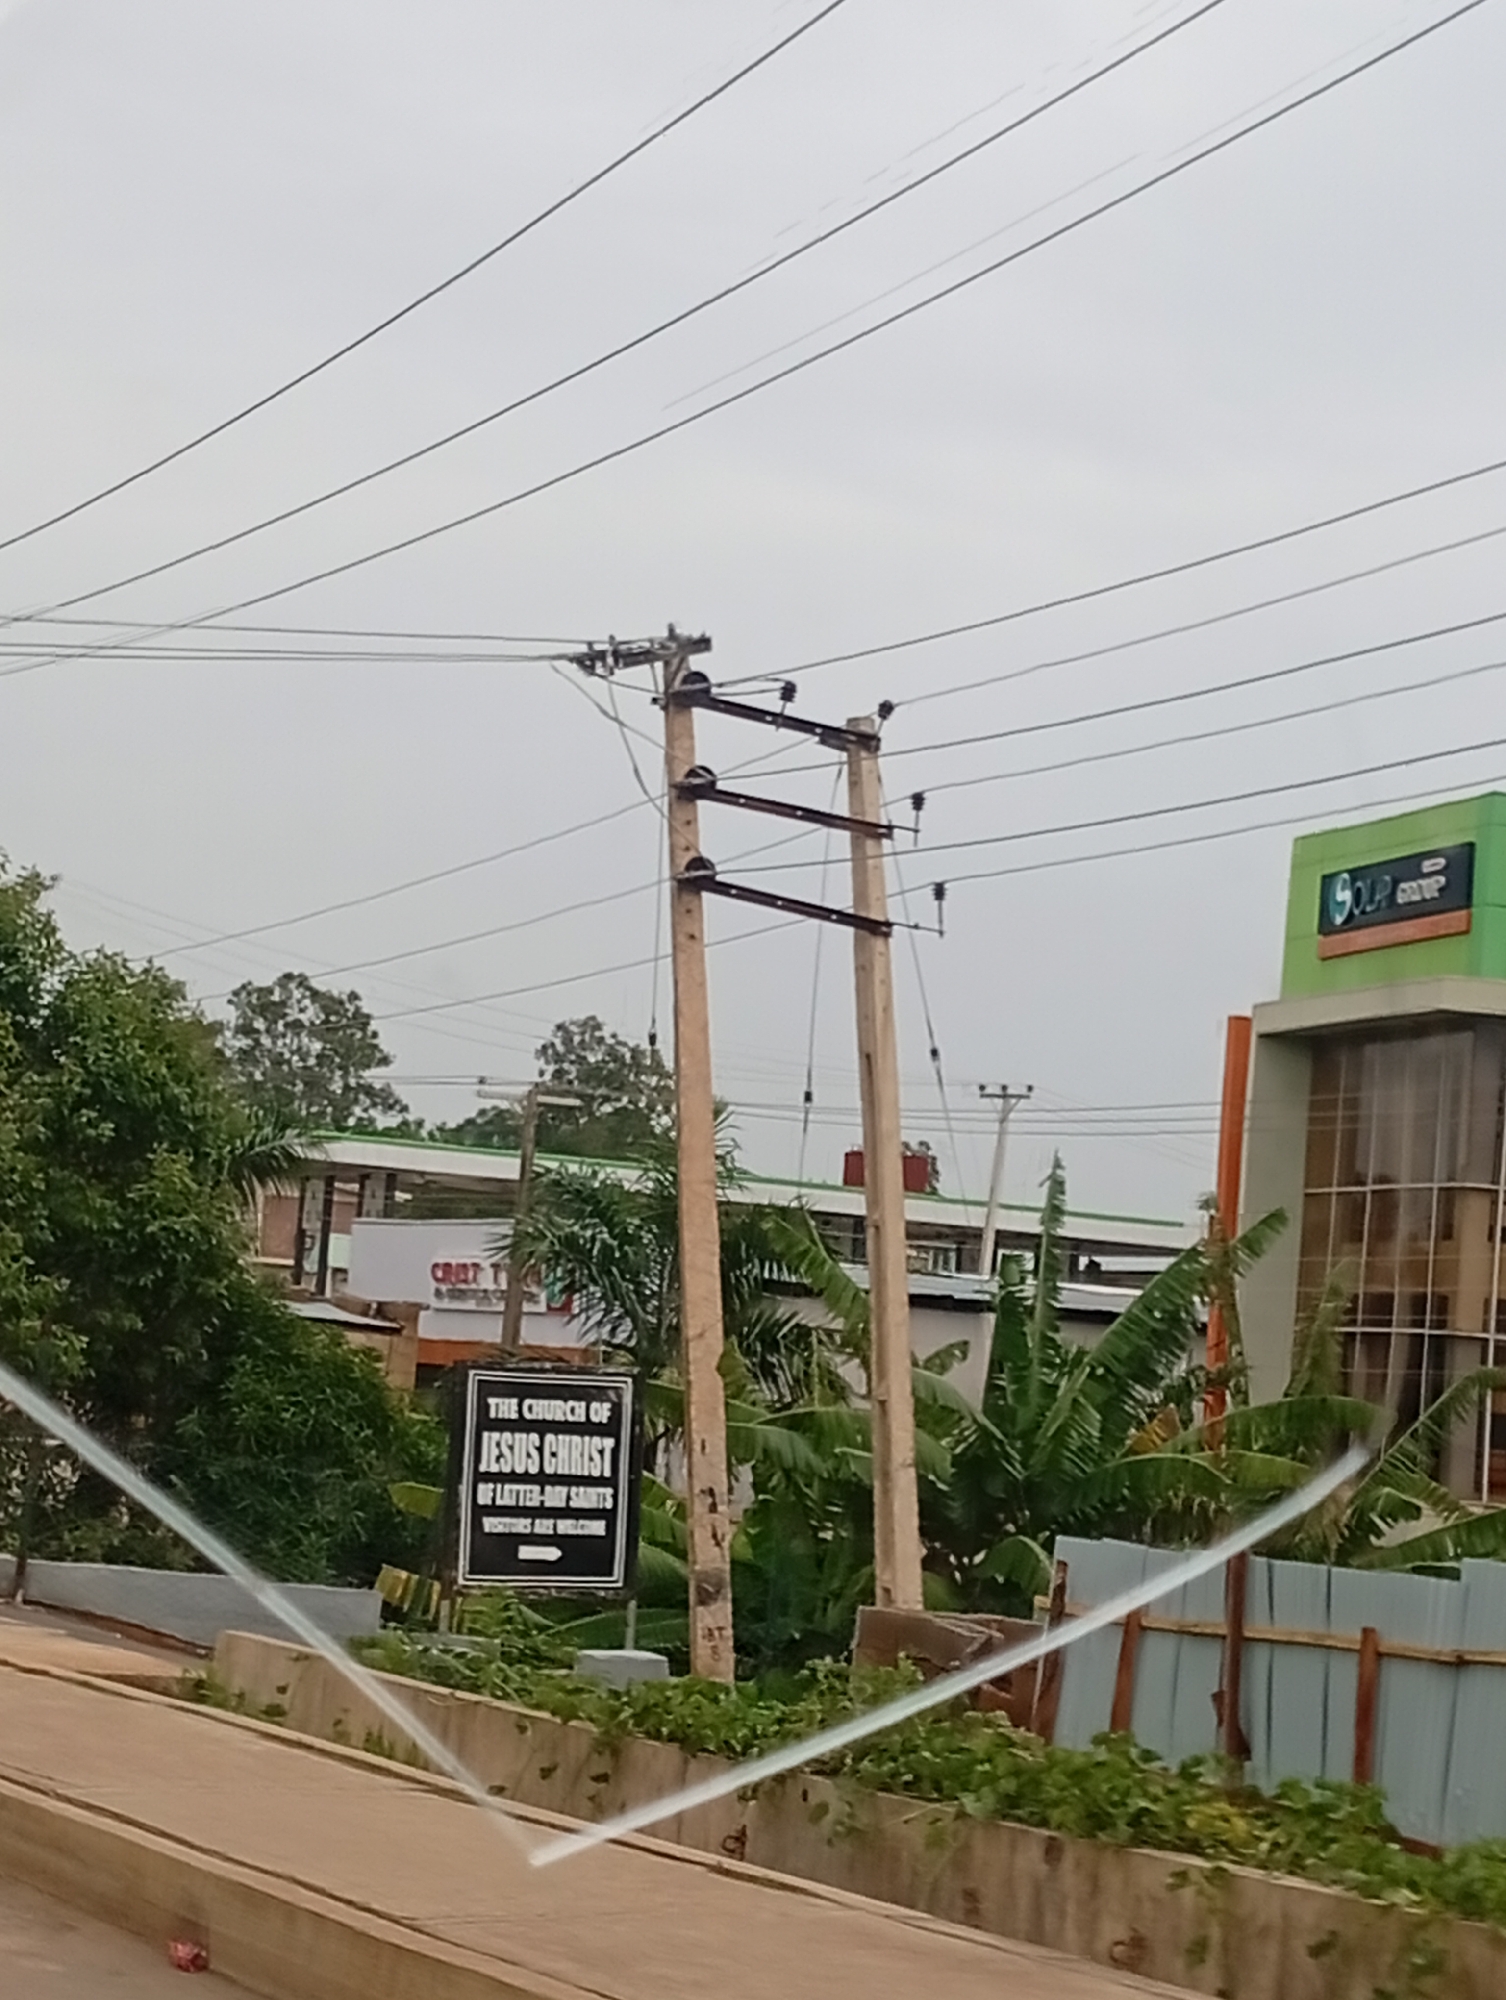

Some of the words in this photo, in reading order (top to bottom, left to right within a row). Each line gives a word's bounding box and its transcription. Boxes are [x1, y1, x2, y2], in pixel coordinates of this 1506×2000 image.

[487, 1397, 519, 1420] THE
[522, 1398, 586, 1422] CHURCH
[589, 1401, 612, 1424] OF
[479, 1431, 540, 1475] JESUS
[543, 1433, 615, 1478] CHRIST
[476, 1482, 495, 1506] OF
[495, 1483, 569, 1508] LATTER-DAY
[569, 1486, 614, 1510] SAINTS
